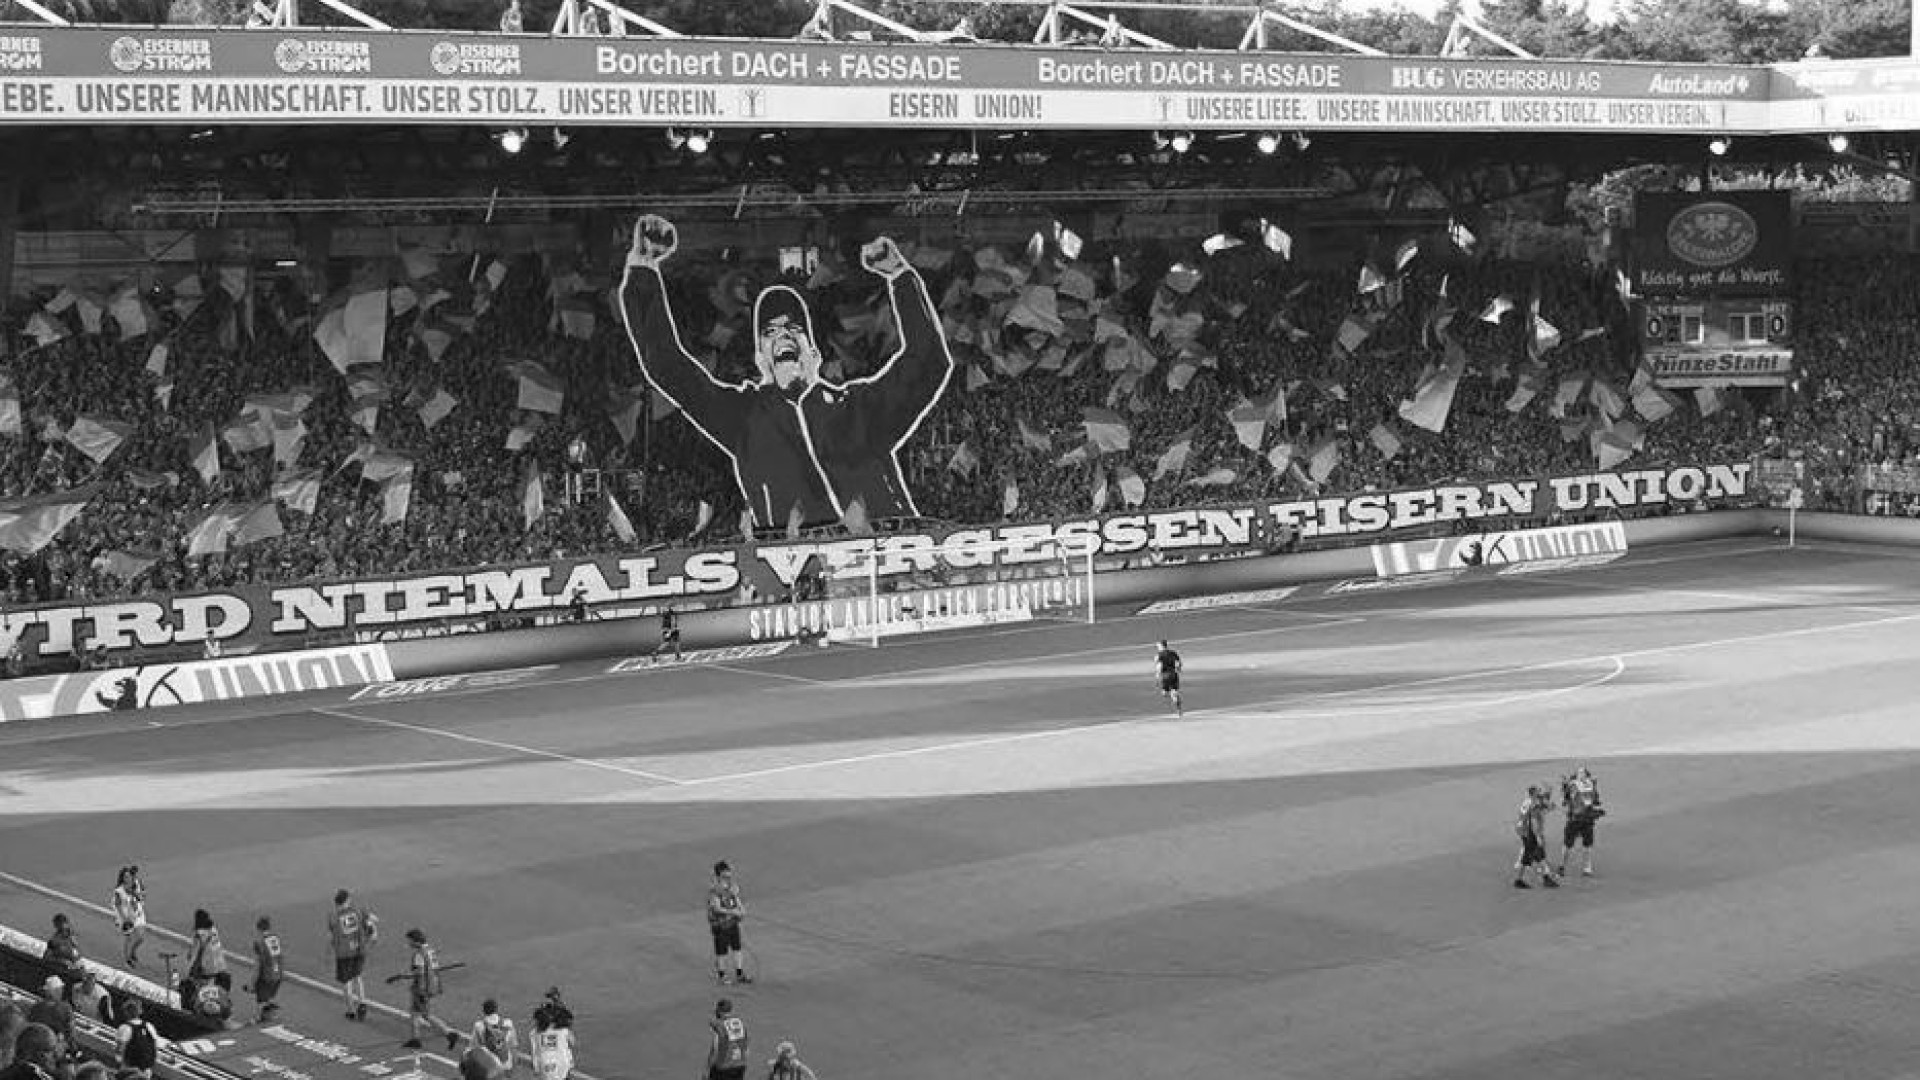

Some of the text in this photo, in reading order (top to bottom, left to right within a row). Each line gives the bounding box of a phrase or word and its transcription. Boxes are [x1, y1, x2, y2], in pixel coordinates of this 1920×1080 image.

[597, 46, 722, 75] Borchert
[732, 52, 807, 77] DACH
[840, 55, 961, 80] FASSADE
[1038, 57, 1142, 84] Borchert
[1151, 62, 1214, 84] DACH
[1241, 63, 1340, 88] FASSADE
[1392, 67, 1600, 91] BUG VERKEHRSBAU AG
[77, 84, 181, 112] UNSERE
[193, 83, 371, 112] MANNSCHAFT.
[383, 86, 461, 112] UNSER
[469, 87, 546, 113] STOLZ.
[560, 88, 631, 114] UNSER
[640, 89, 724, 115] VEREIN.
[891, 93, 1042, 118] EISERN UNION!
[1187, 96, 1253, 119] UNSERE
[1317, 99, 1379, 121] UNSERE
[1387, 100, 1494, 122] MANNSCHAFT.
[1502, 101, 1550, 122] UNSER
[1609, 103, 1652, 124] UNSER
[271, 550, 740, 633] NIEMALS
[1269, 481, 1537, 536] EISERN
[1550, 464, 1750, 511] UNION
